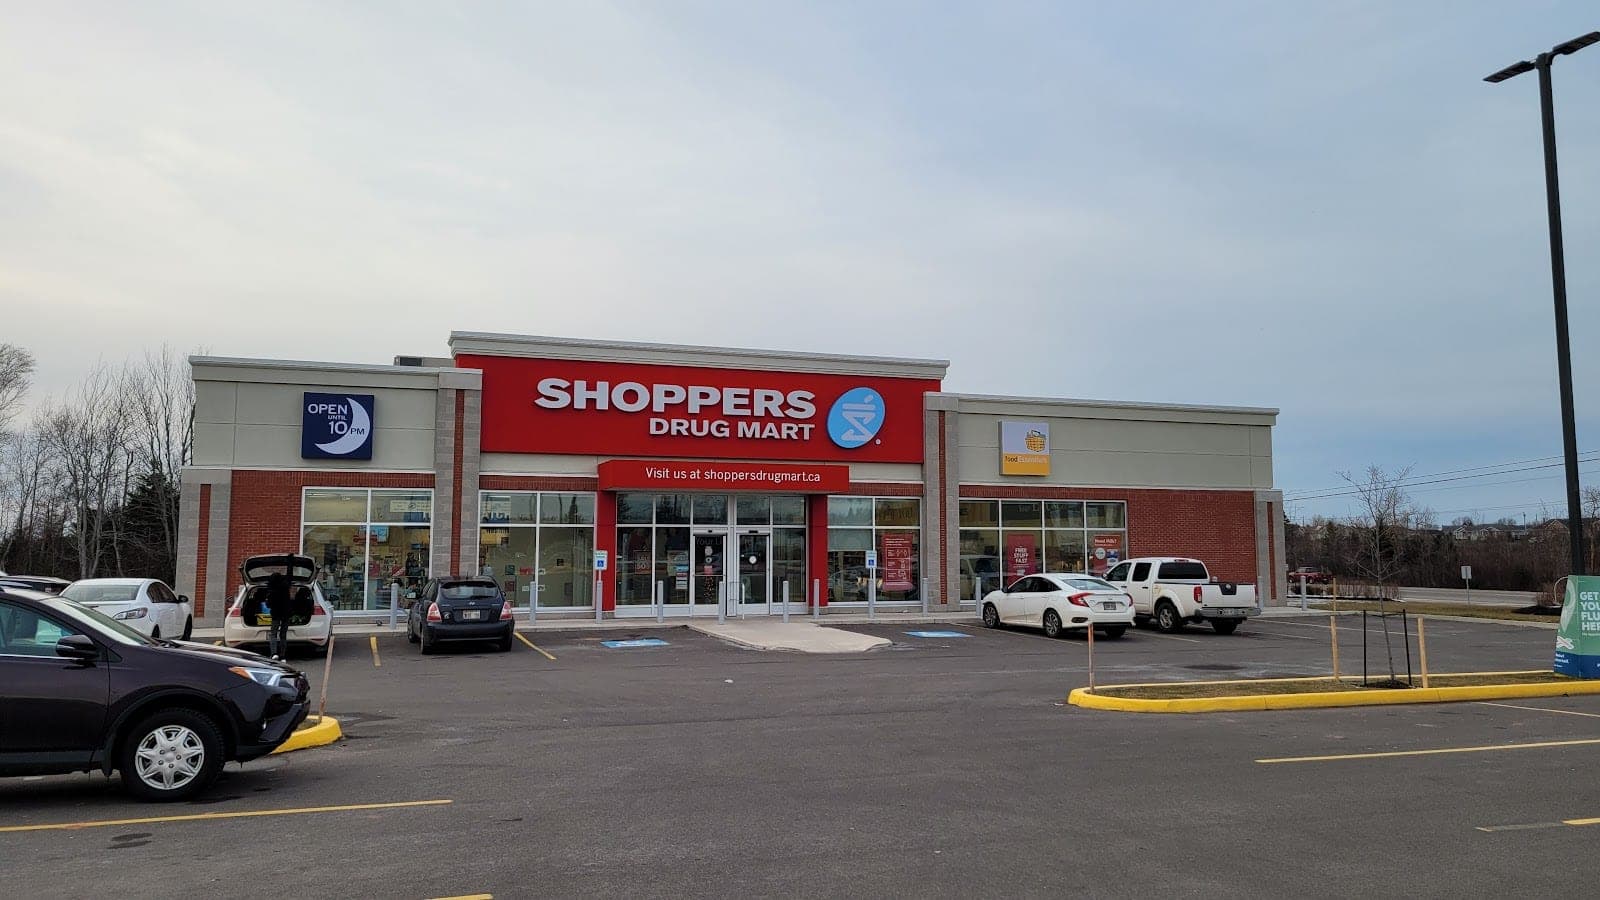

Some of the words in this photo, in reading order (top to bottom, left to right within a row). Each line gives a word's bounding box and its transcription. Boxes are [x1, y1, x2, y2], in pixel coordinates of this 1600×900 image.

[534, 377, 817, 419] SHOPPERS
[308, 403, 348, 414] OPEN
[328, 421, 348, 435] 10
[350, 427, 365, 435] PM
[649, 417, 730, 438] DRUG
[737, 421, 815, 440] MART
[645, 466, 670, 479] Visit
[673, 470, 687, 479] us
[689, 468, 701, 480] at
[703, 468, 821, 484] shoppersdrugmart.ca
[1580, 591, 1600, 601] GET
[1581, 611, 1600, 621] FLU
